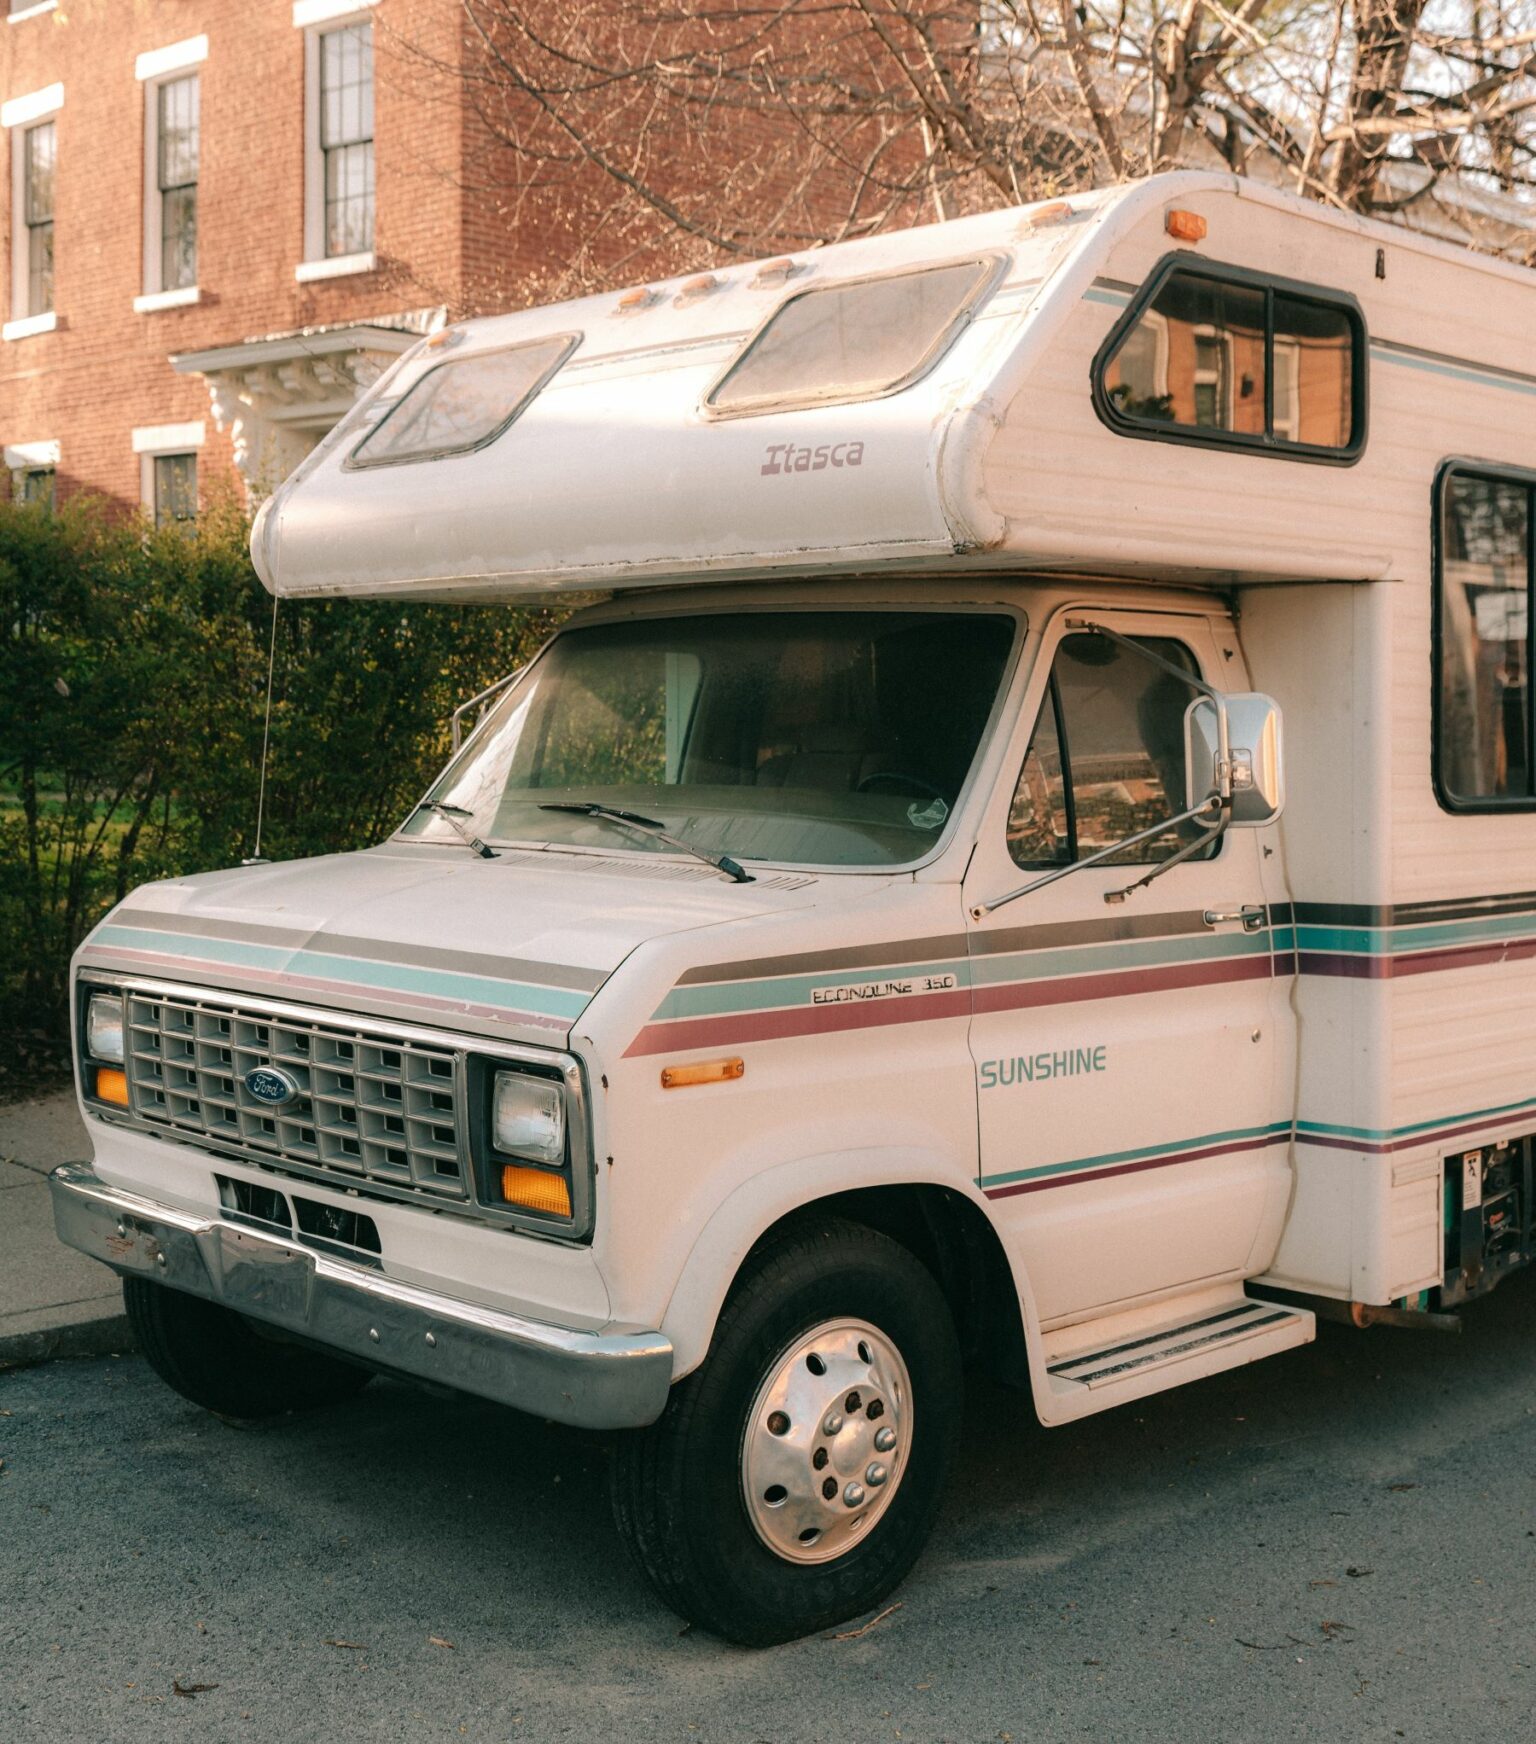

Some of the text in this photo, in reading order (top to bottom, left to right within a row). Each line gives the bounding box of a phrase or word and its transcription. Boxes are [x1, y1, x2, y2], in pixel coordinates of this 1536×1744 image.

[761, 441, 864, 475] Itasca
[813, 976, 954, 1004] ECONOLINE 350
[981, 1046, 1106, 1088] SUNSHINE
[253, 1074, 279, 1096] Ford
